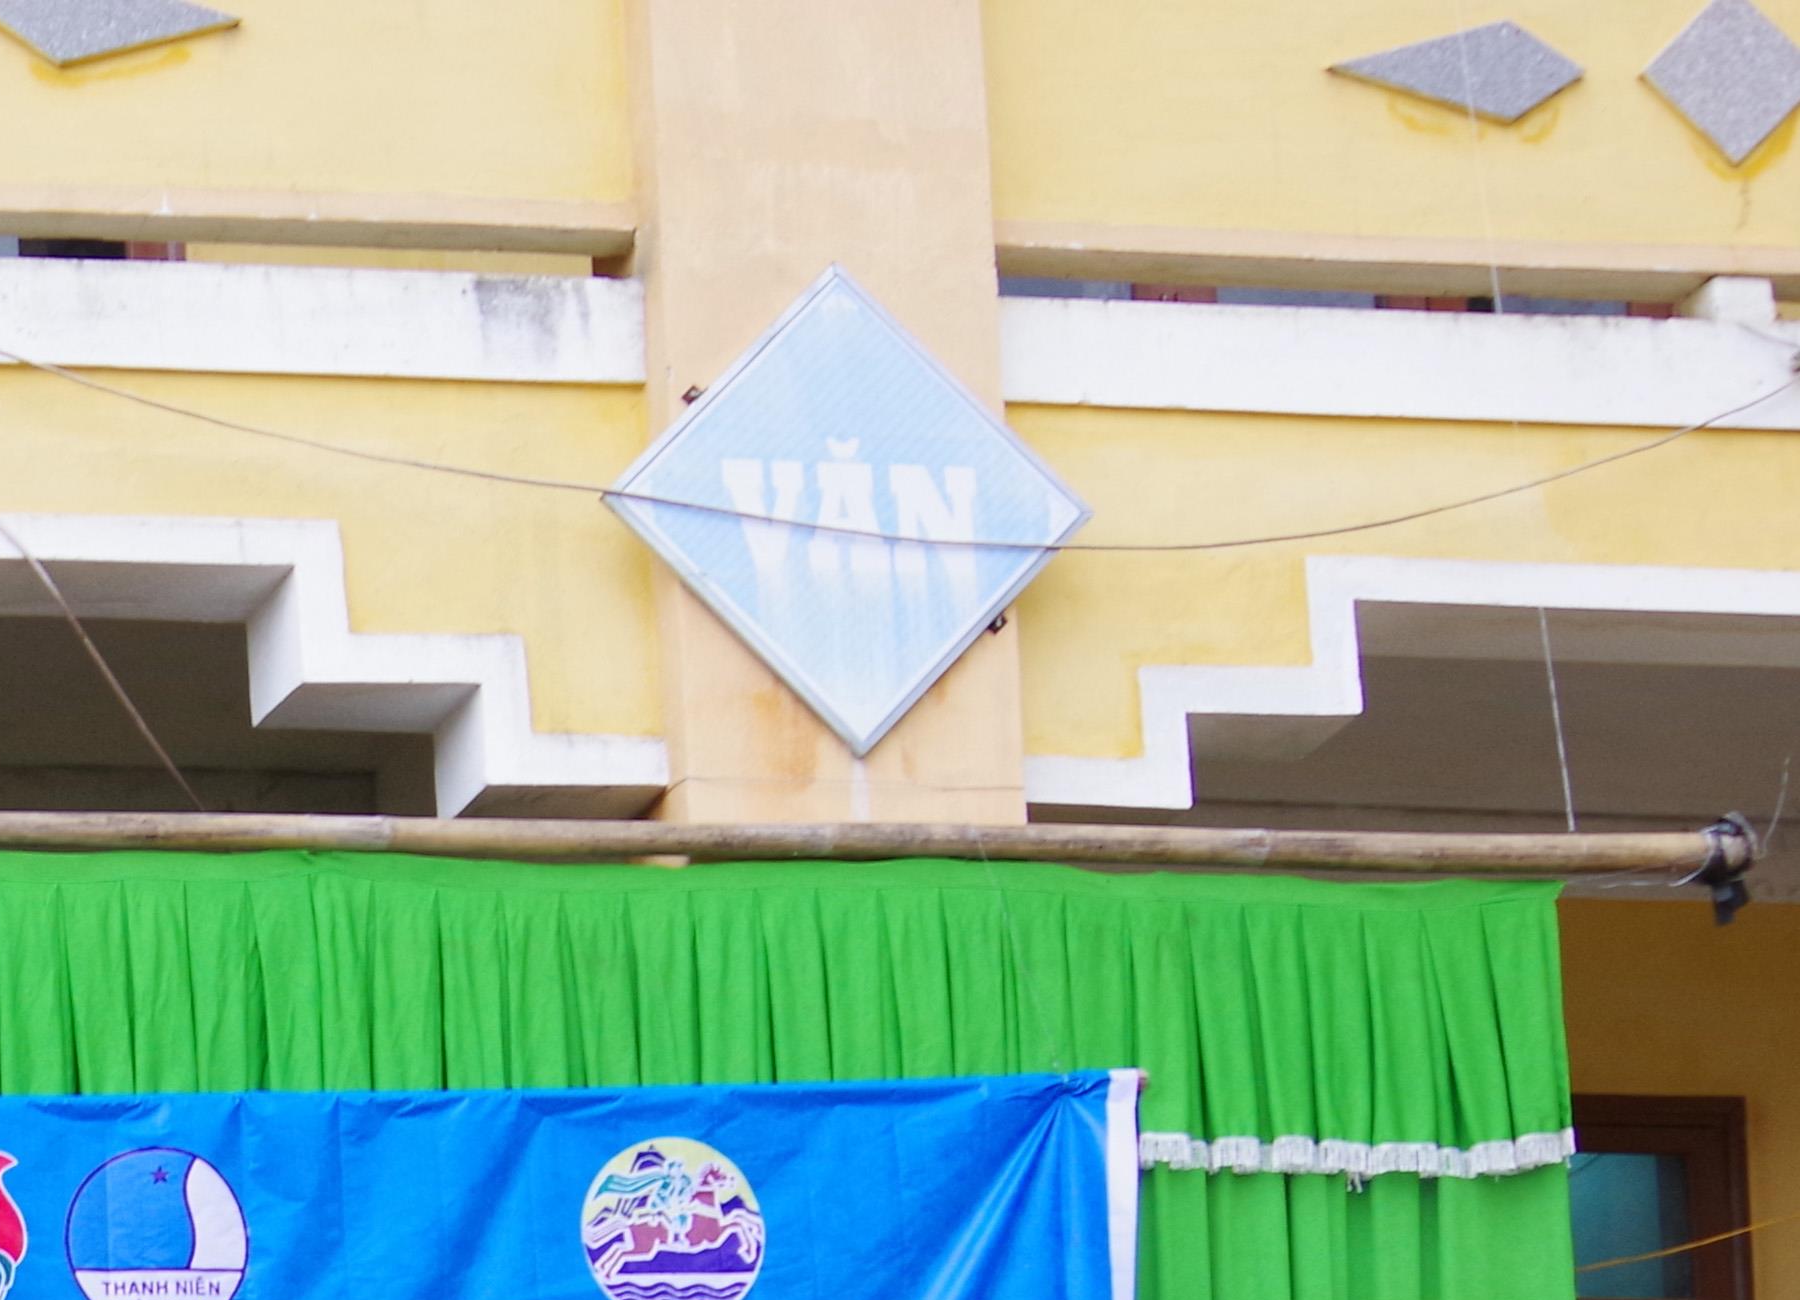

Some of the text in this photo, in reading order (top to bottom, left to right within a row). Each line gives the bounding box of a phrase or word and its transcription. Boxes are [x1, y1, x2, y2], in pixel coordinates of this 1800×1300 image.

[719, 436, 979, 588] VĂN
[102, 1275, 220, 1296] THANH NIÊN
